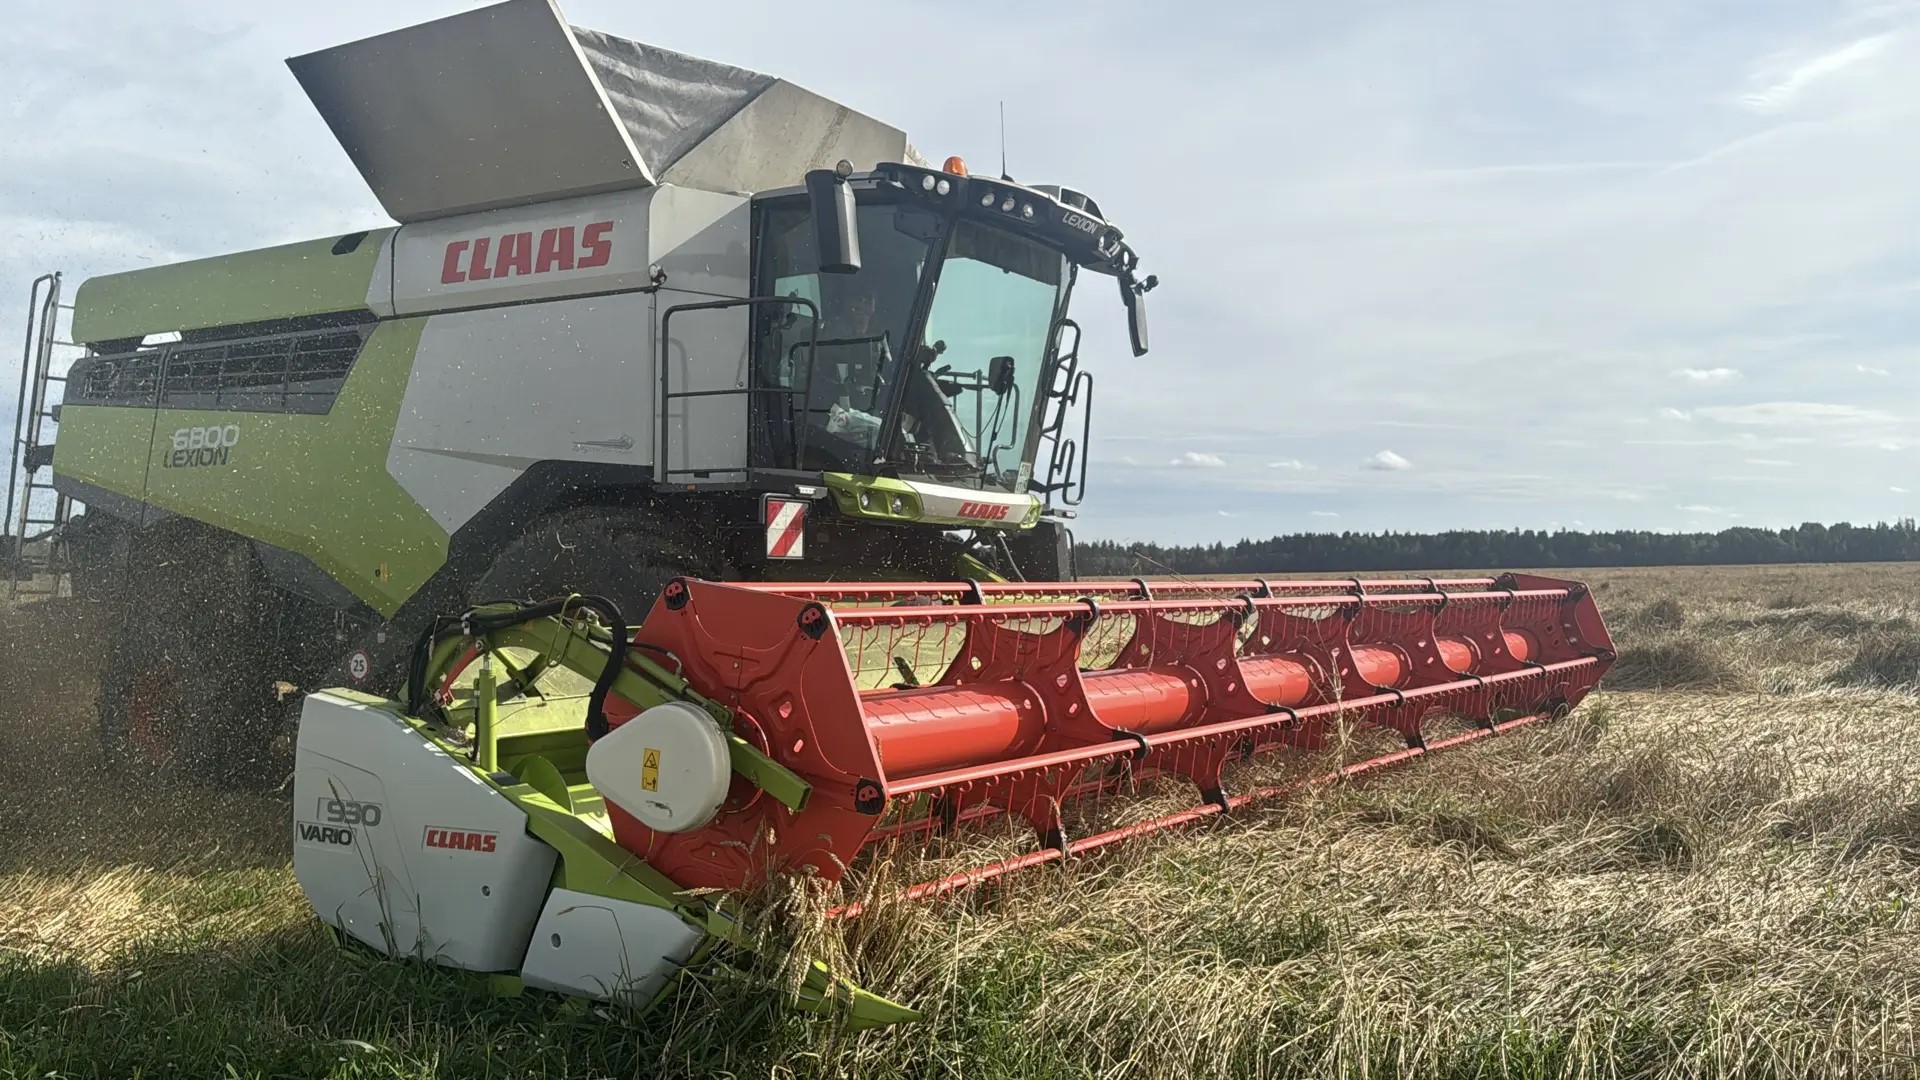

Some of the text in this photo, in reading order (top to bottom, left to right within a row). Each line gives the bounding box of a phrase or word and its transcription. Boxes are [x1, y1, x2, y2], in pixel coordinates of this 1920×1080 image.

[1062, 211, 1099, 234] LEXION
[441, 221, 614, 284] CLAAS
[173, 425, 240, 450] 6800
[163, 447, 229, 468] LEXION
[957, 501, 1010, 520] CLAAS
[353, 659, 365, 672] 25
[327, 800, 382, 827] 930
[300, 824, 353, 846] VARIO
[426, 829, 497, 853] CLAAS
